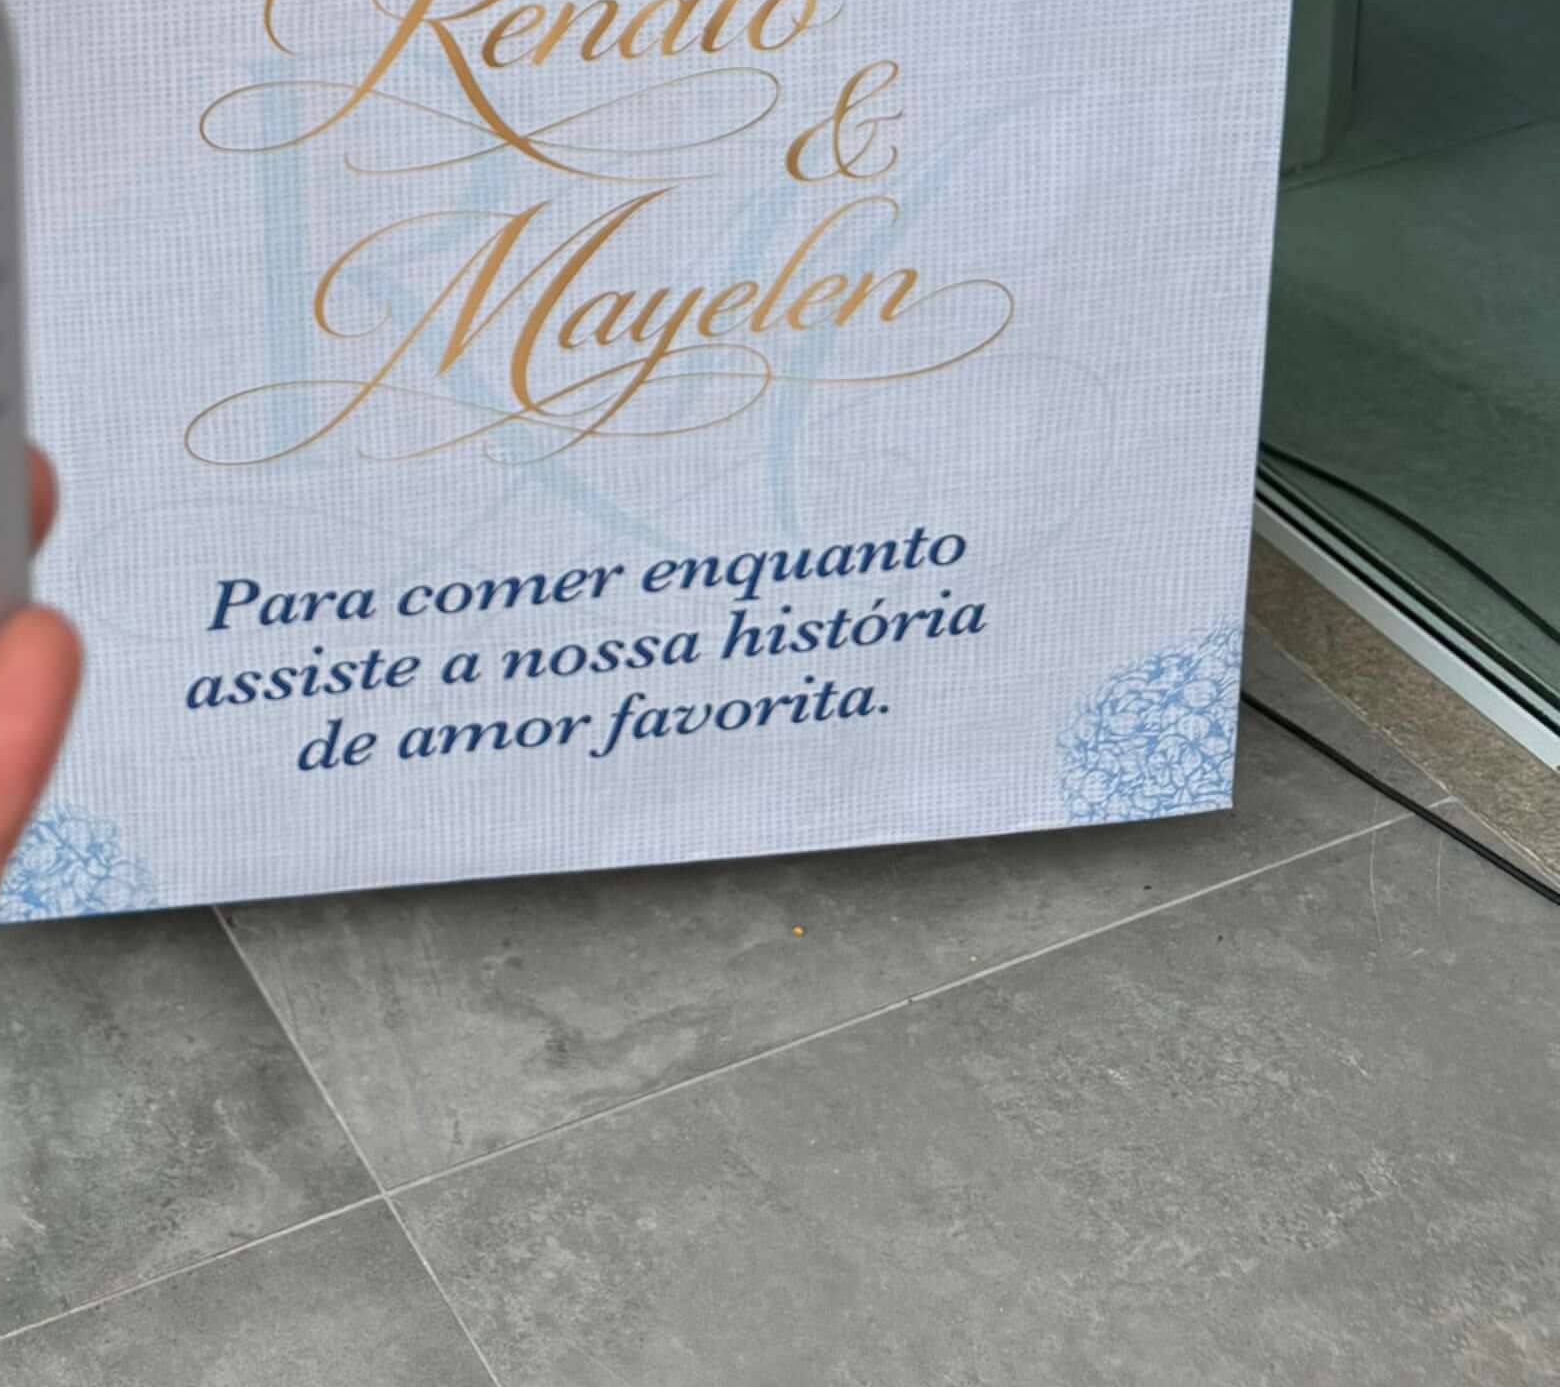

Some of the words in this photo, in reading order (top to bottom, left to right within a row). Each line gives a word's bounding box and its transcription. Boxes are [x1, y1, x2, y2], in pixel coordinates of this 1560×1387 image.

[785, 60, 903, 182] &
[184, 185, 1014, 466] Mayelen
[207, 577, 377, 631] Para
[396, 563, 624, 617] comer
[640, 526, 968, 607] enquanto
[185, 644, 422, 709] assiste
[440, 651, 482, 686] a
[501, 631, 702, 680] nossa
[720, 595, 988, 660] história
[296, 718, 377, 772] de
[397, 714, 593, 761] amor
[588, 680, 892, 758] favorita.
